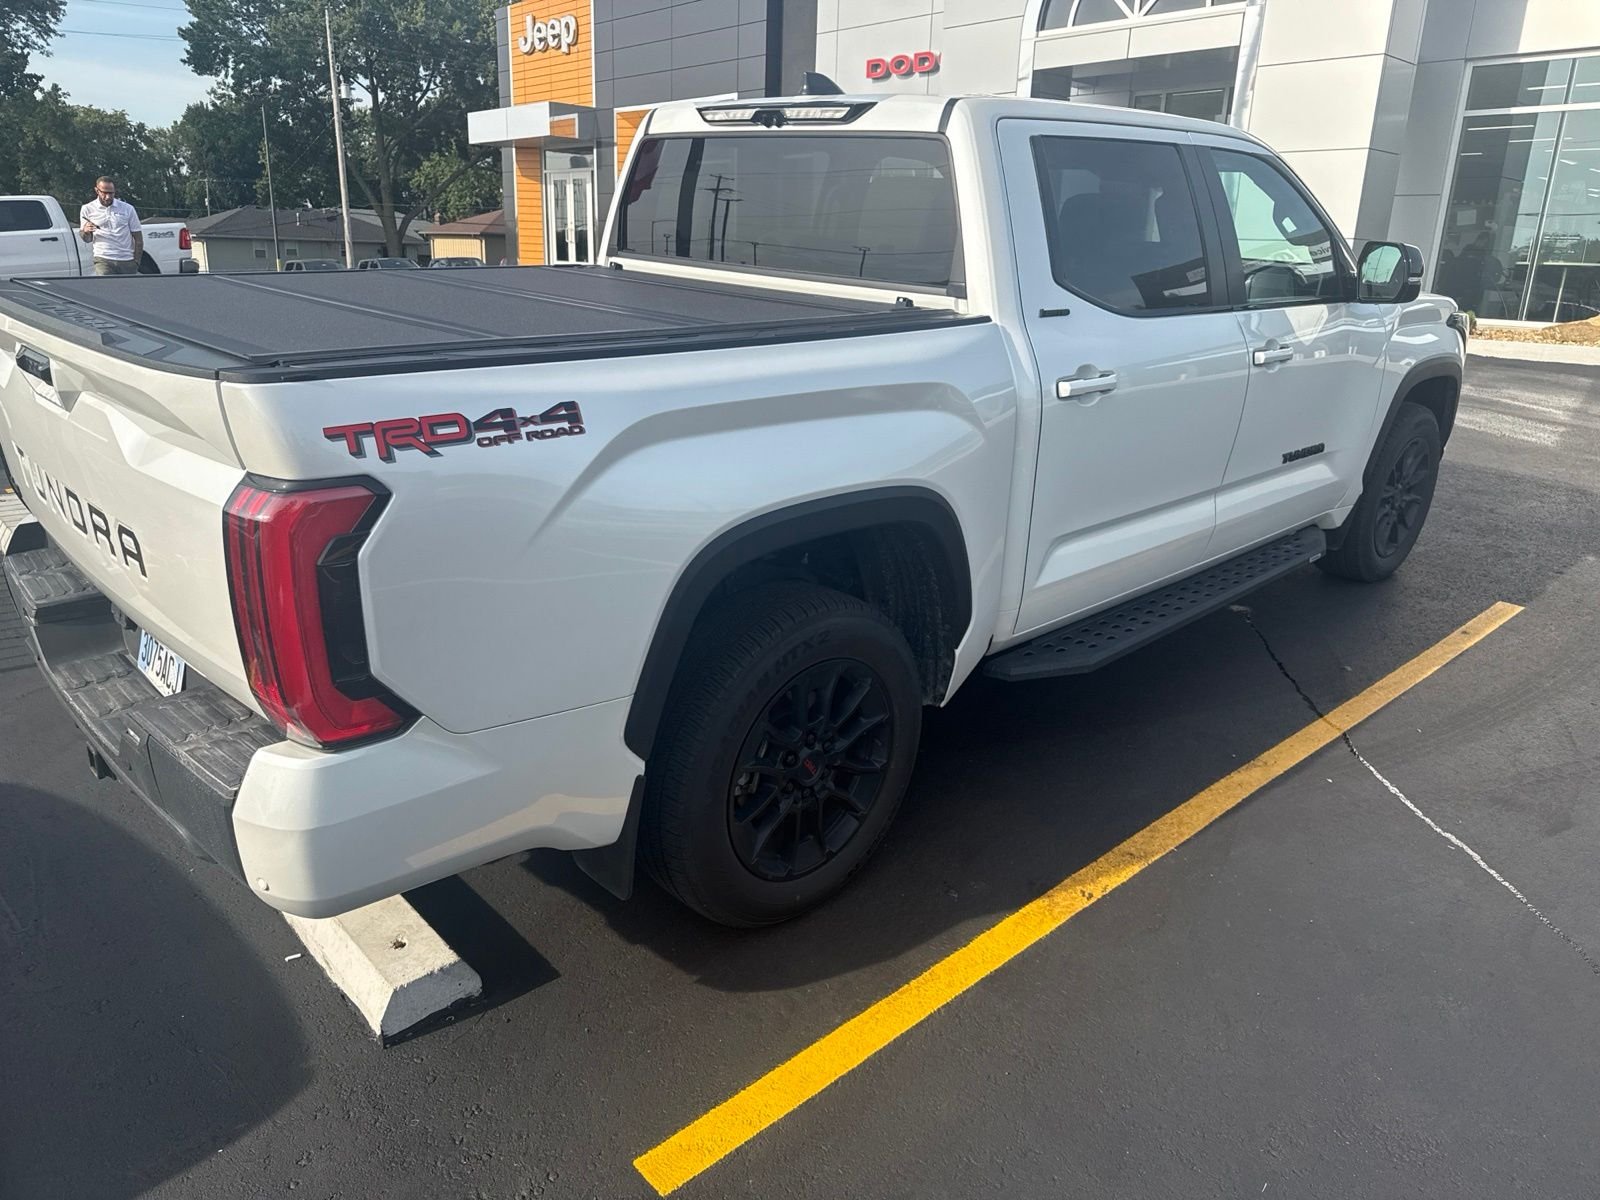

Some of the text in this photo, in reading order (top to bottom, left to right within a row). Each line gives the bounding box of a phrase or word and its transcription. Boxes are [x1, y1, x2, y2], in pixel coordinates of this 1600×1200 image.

[518, 13, 579, 56] Jeep
[865, 50, 942, 80] DOD
[323, 400, 584, 464] TRD 4x4
[476, 424, 586, 448] OFF ROAD
[12, 440, 148, 581] TUNDRA
[141, 631, 181, 694] 3075ACJ
